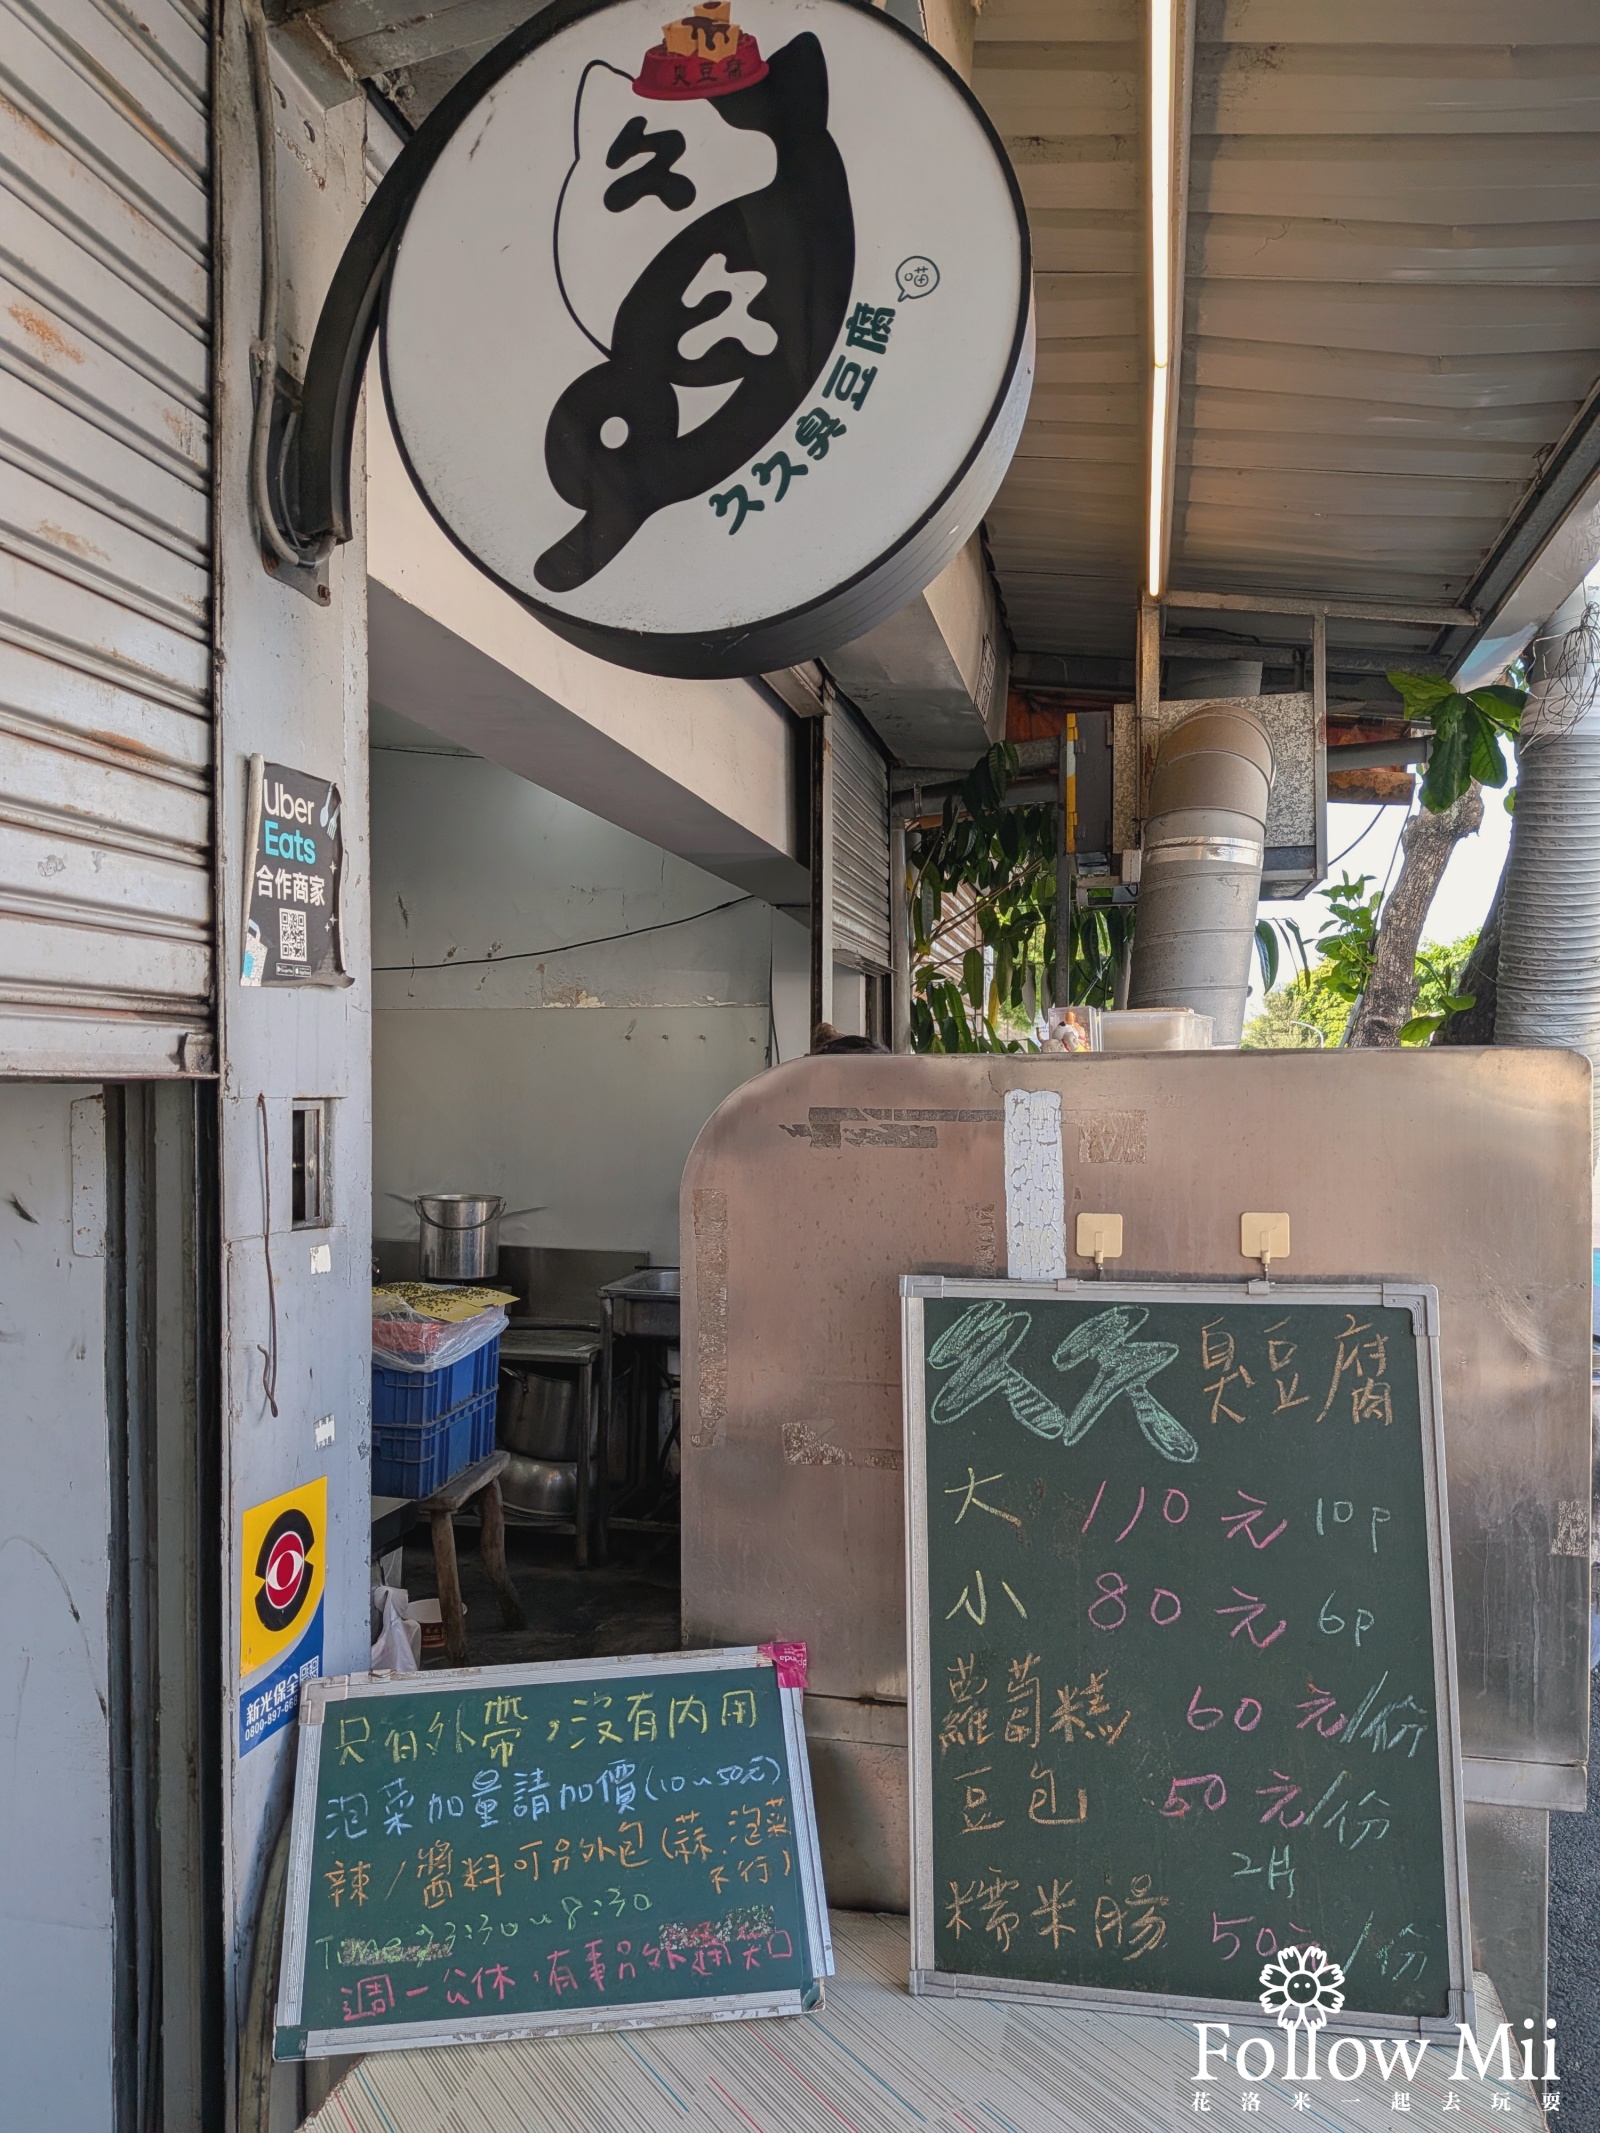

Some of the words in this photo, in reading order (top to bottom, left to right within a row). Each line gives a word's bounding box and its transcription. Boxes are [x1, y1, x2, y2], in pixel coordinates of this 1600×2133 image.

[671, 57, 742, 86] 臭豆腐
[708, 301, 896, 536] 久久臭豆腐
[262, 778, 315, 825] Uber
[263, 818, 317, 865] Eats
[255, 864, 326, 907] 合作商家
[944, 1467, 1023, 1528] 大
[945, 1569, 1029, 1626] 小
[244, 1694, 299, 1741] 0800-897-668
[245, 1672, 299, 1727] 新光保全
[938, 1652, 1131, 1749] 蘿蔔糕
[953, 1761, 1088, 1835] 豆包
[1231, 1844, 1296, 1899] 2片
[946, 1865, 1170, 1961] 糯米腸
